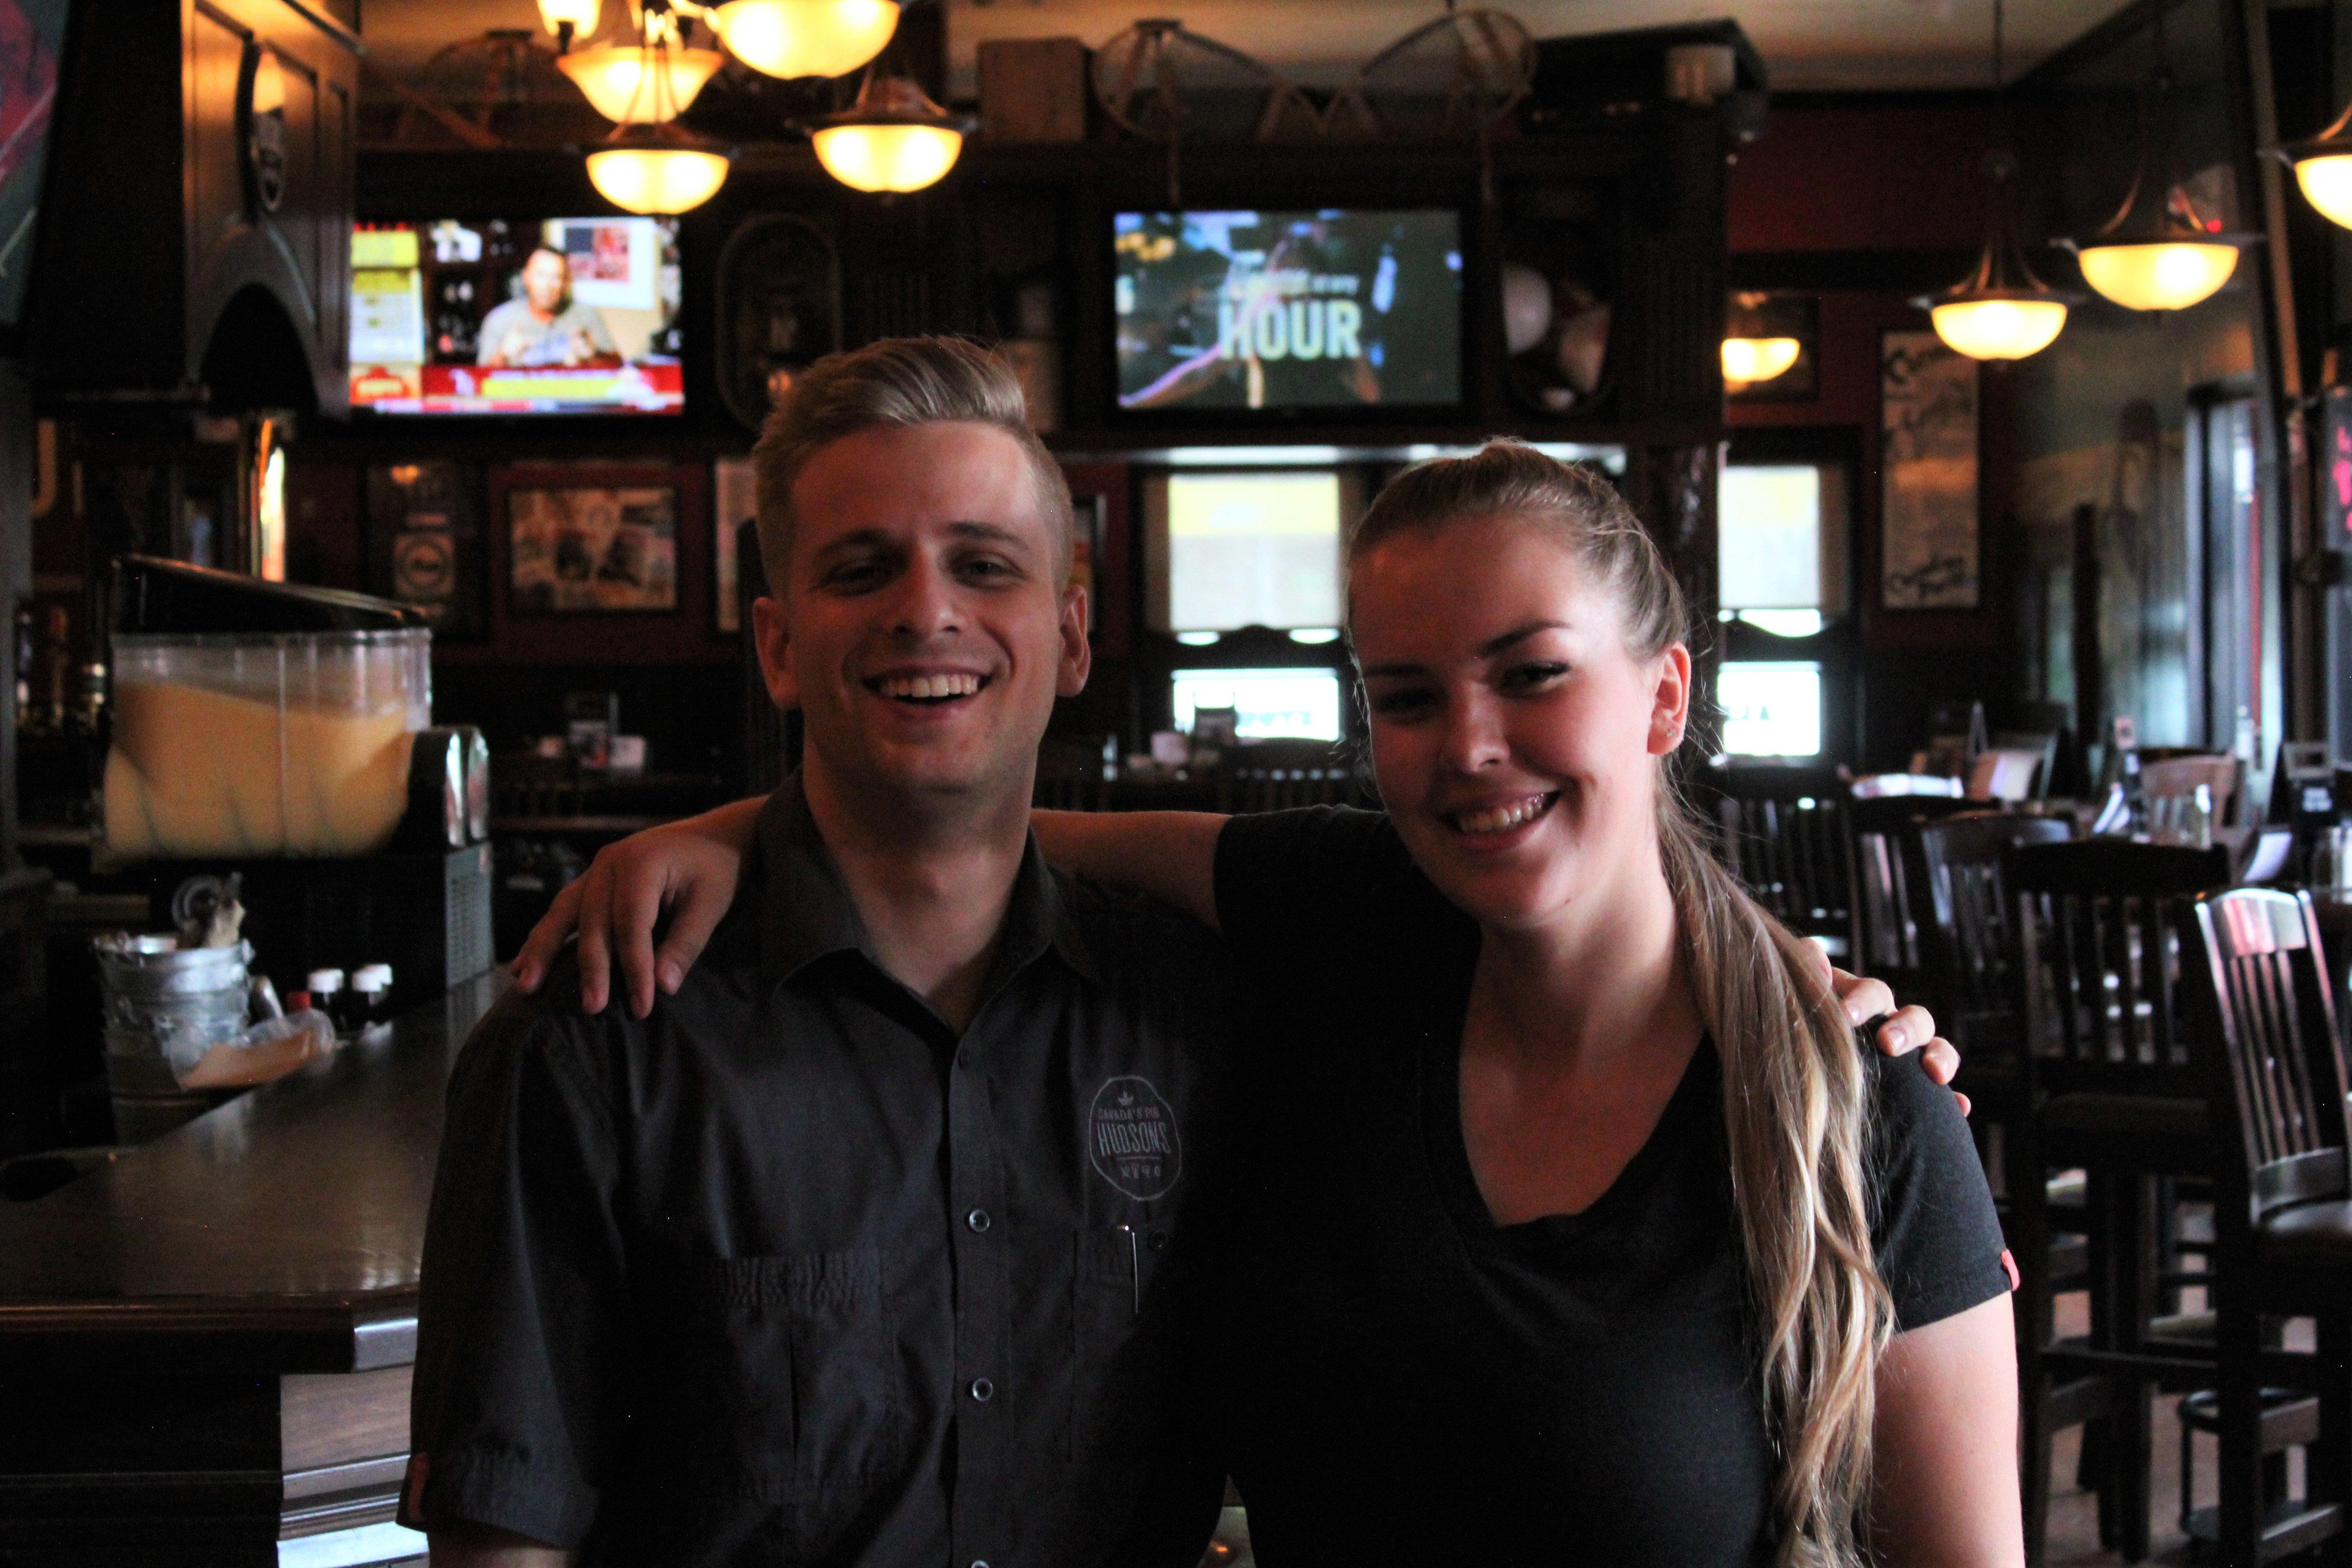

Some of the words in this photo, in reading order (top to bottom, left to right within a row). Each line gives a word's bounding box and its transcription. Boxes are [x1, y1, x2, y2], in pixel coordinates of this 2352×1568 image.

[1218, 299, 1362, 360] HOUR
[1098, 1107, 1143, 1121] CANADA'S
[1097, 1122, 1171, 1157] HUDSONS
